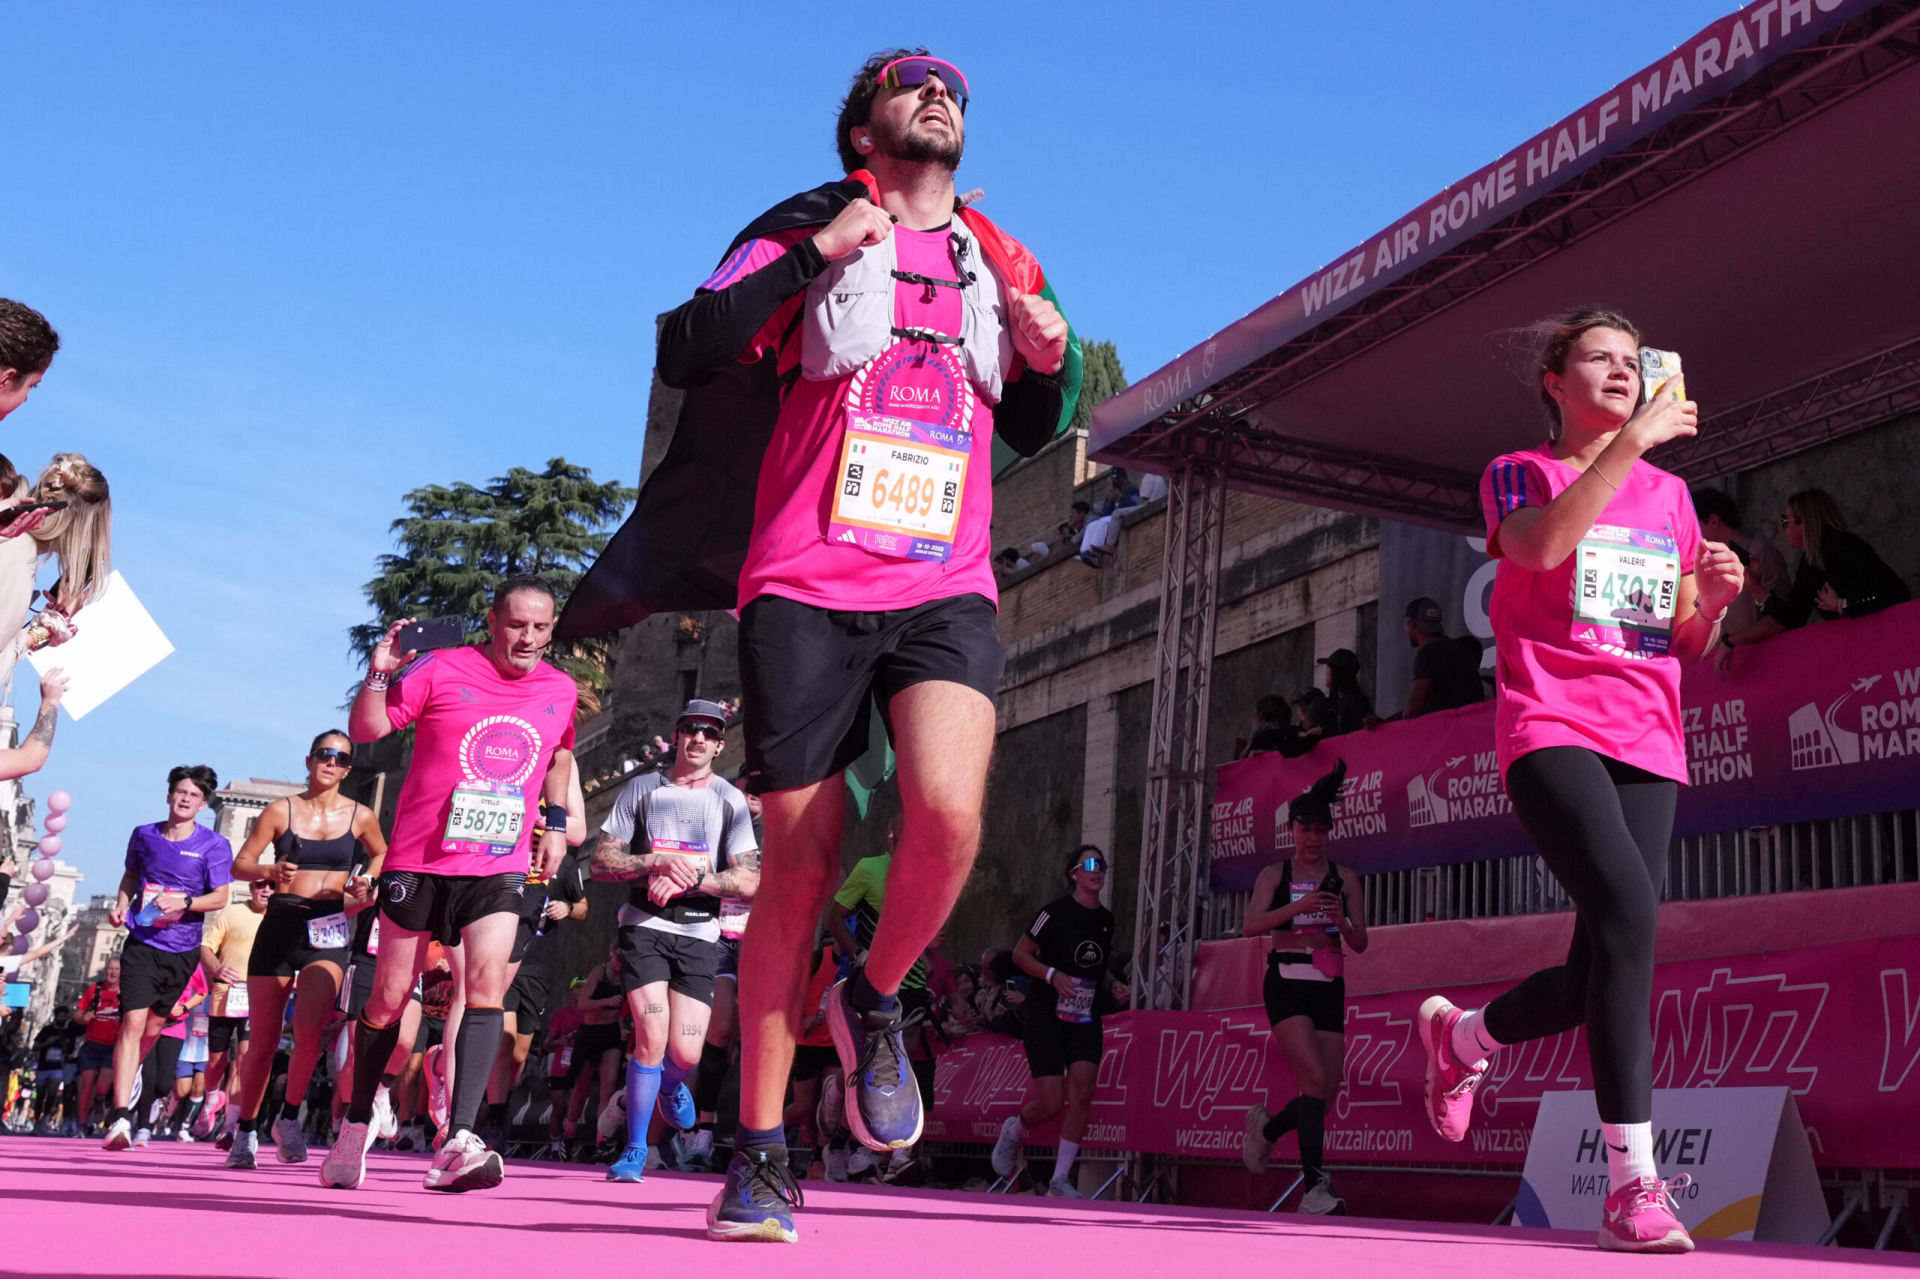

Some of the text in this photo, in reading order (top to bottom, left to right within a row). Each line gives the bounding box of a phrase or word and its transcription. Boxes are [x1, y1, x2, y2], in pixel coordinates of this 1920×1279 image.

[1301, 0, 1844, 318] WIZZ AIR ROME HALF MARATH
[942, 353, 960, 379] ROME
[889, 385, 942, 404] ROMA
[1144, 365, 1192, 415] ROMA
[871, 426, 911, 438] MARATHON
[873, 421, 893, 431] ROME
[930, 431, 954, 444] ROMA
[891, 450, 930, 466] FABRIZIO
[871, 468, 935, 517] 6489
[1645, 535, 1666, 546] ROMA
[1618, 555, 1646, 566] VALERIE
[1601, 571, 1659, 614] 4303
[1711, 699, 1746, 728] AIR
[485, 746, 518, 759] ROMA
[1692, 726, 1748, 758] HALF
[1359, 770, 1384, 792] AIR
[1448, 772, 1500, 799] ROME
[480, 798, 500, 806] OTELLO
[1234, 797, 1254, 816] AIR
[1345, 792, 1383, 816] HALF
[464, 808, 508, 834] 5879
[1224, 816, 1254, 837] HALF
[321, 922, 348, 944] 3037
[1082, 1118, 1126, 1142] zair.com
[1576, 1128, 1712, 1165] HWEI
